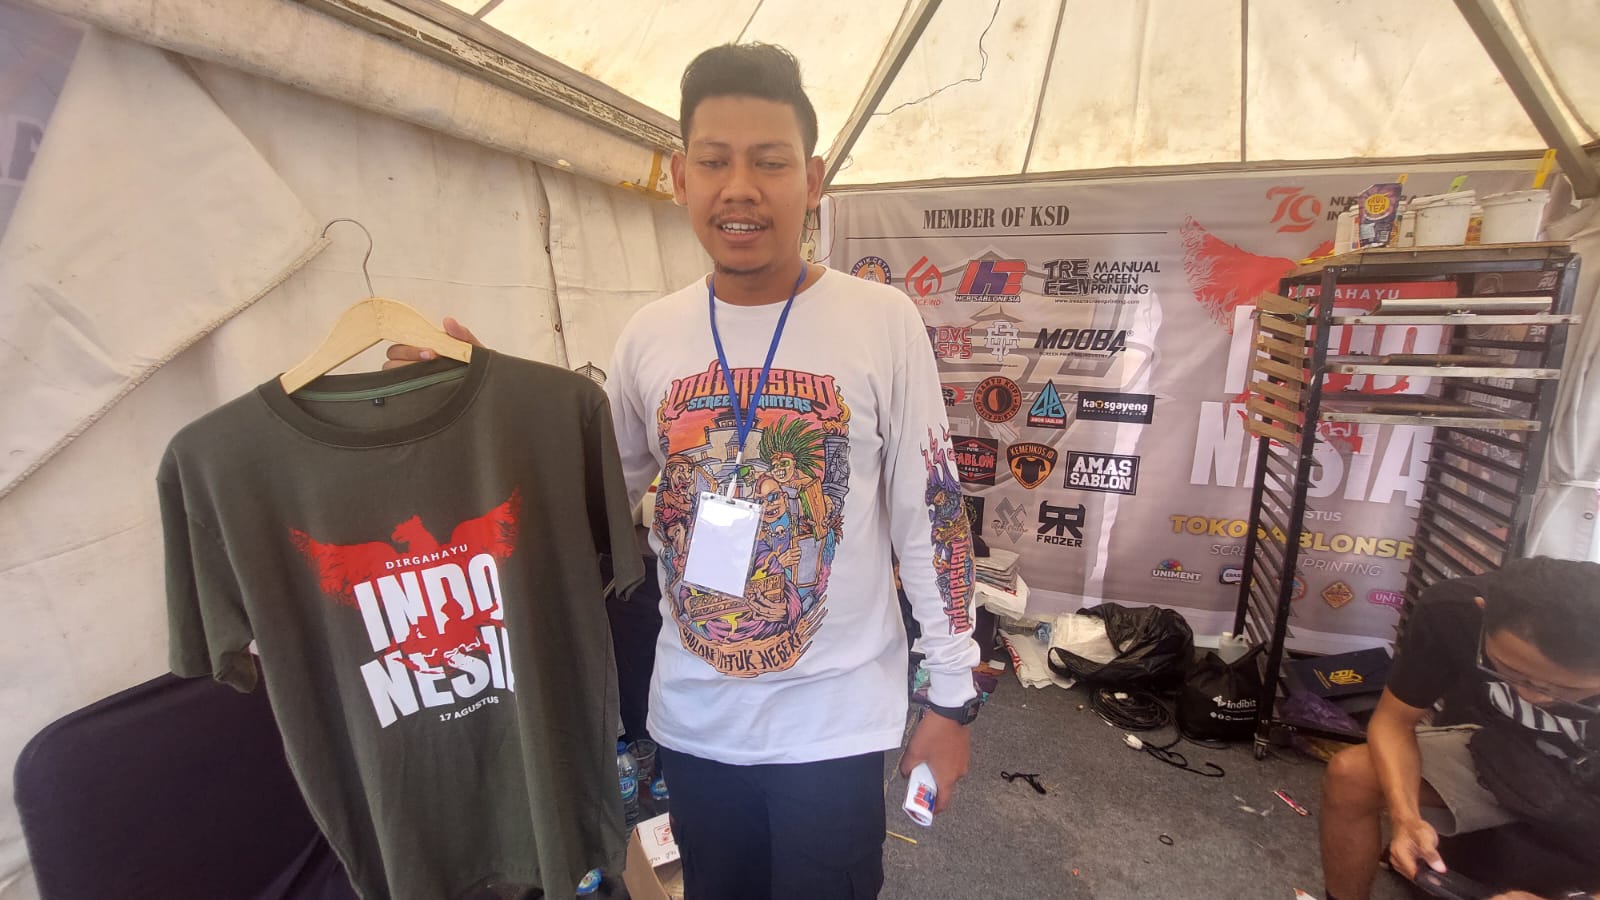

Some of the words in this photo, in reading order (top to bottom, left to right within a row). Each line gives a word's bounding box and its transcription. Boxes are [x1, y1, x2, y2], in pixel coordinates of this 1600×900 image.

[923, 208, 995, 230] MEMBER
[1001, 206, 1025, 228] OF
[1030, 205, 1070, 227] KSD
[1093, 261, 1161, 273] MANUAL
[1092, 273, 1139, 284] SCREEN
[1090, 284, 1149, 295] PRINTING
[938, 327, 972, 343] DVC
[938, 344, 972, 359] SPS
[688, 394, 735, 411] SCREE
[750, 395, 812, 412] RINTERS
[956, 453, 995, 468] ABLON
[1072, 456, 1132, 476] AMAS
[1069, 473, 1131, 490] SABLON
[1036, 534, 1083, 548] FROZER
[385, 544, 468, 570] DIRGAHAYU
[1151, 569, 1201, 581] UNIMENT
[353, 553, 504, 653] INDO
[439, 712, 453, 722] 17
[454, 695, 500, 721] AGUSTUS
